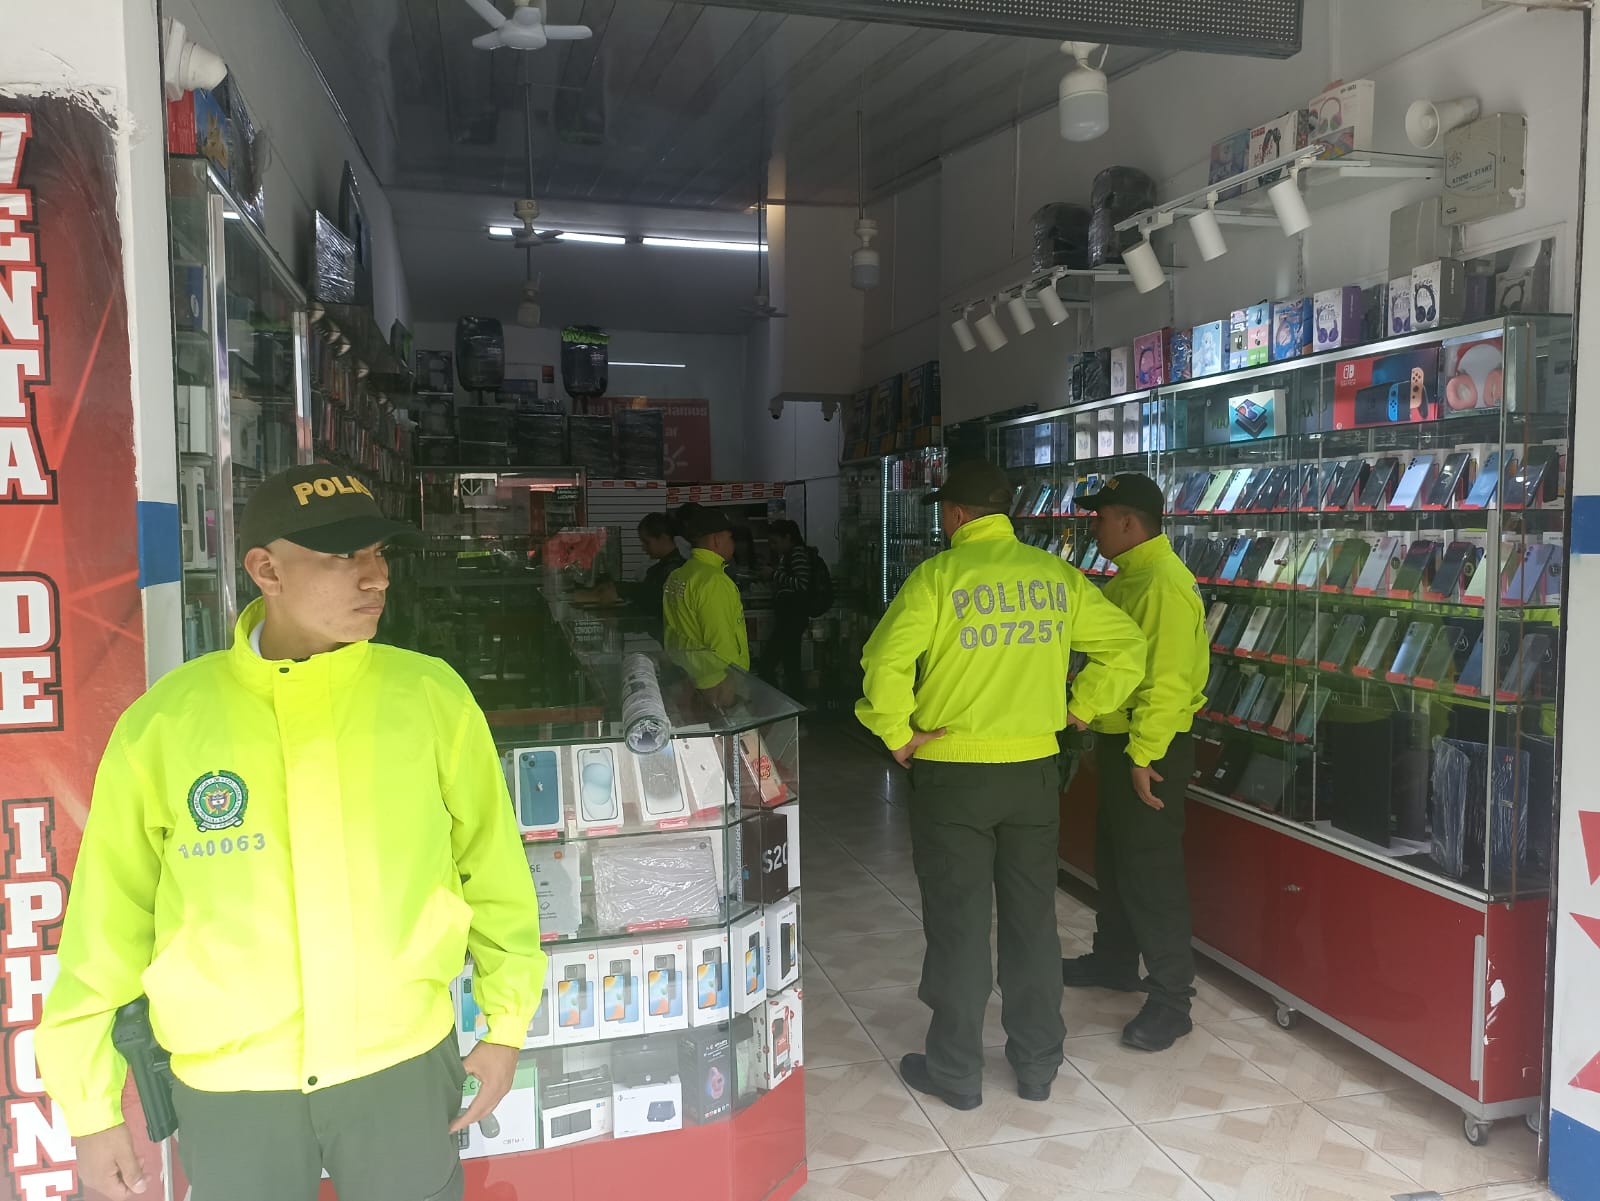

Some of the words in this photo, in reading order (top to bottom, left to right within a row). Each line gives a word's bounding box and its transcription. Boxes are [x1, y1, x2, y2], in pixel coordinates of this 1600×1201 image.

[952, 579, 1067, 619] POLICIA
[0, 581, 54, 723] DE
[178, 833, 266, 859] 140063
